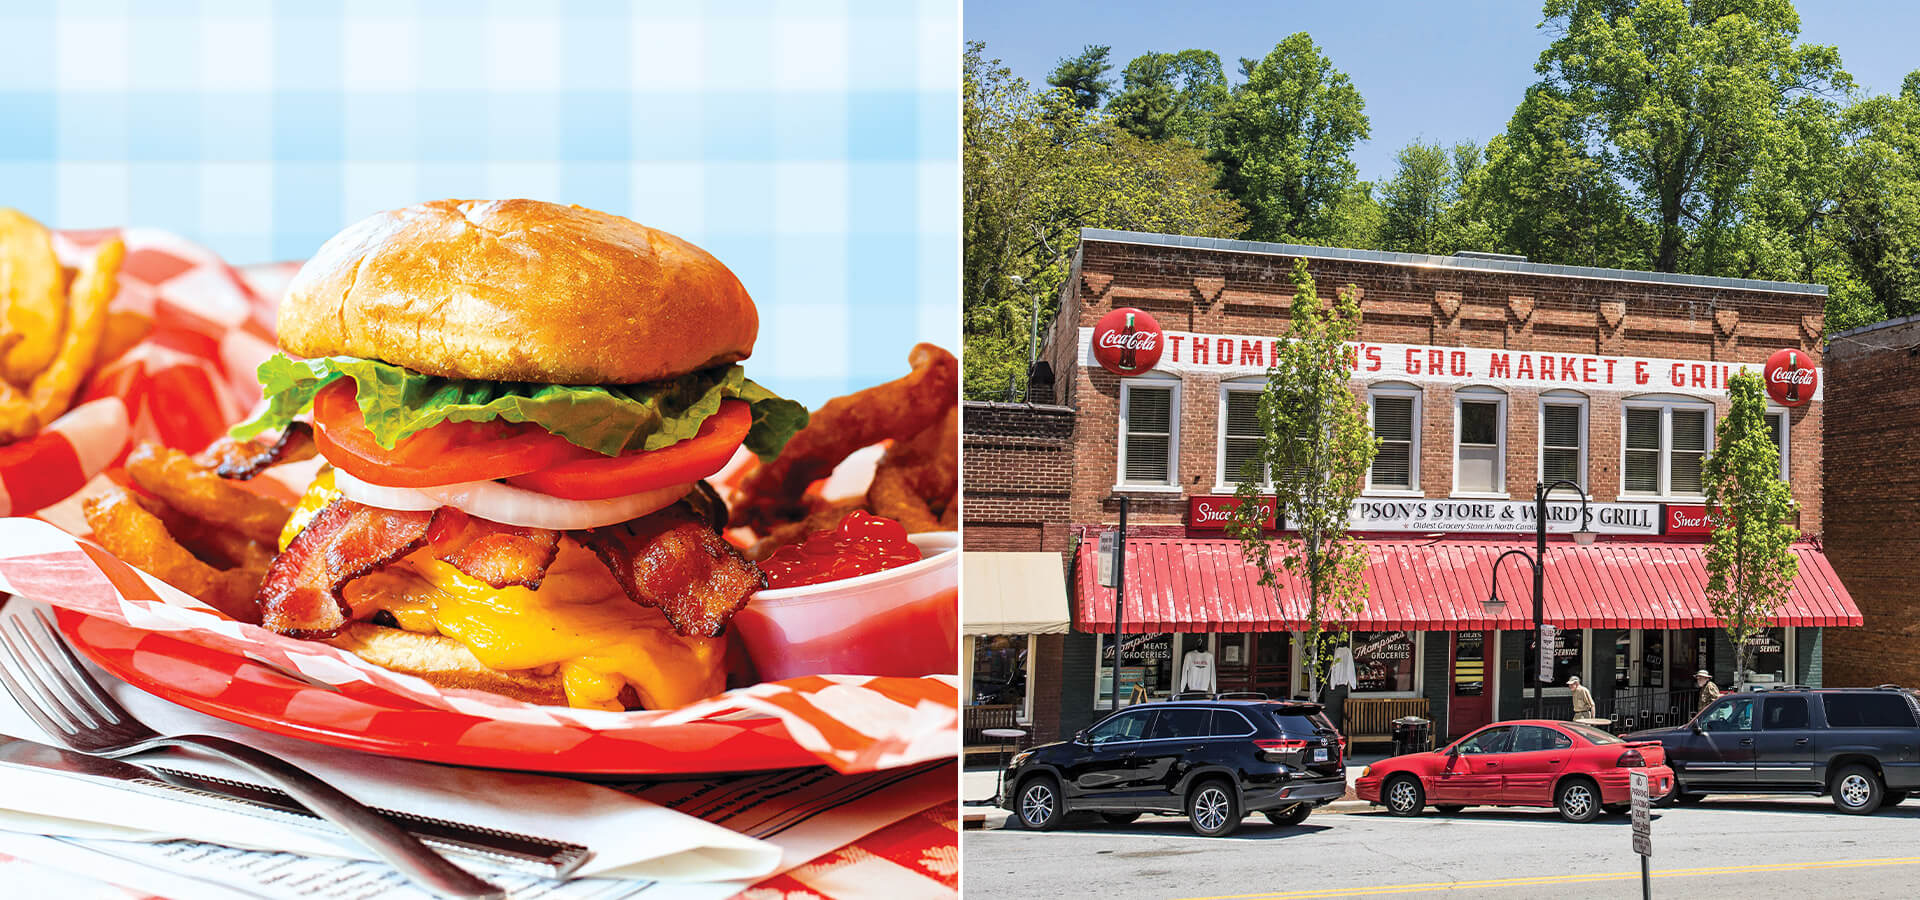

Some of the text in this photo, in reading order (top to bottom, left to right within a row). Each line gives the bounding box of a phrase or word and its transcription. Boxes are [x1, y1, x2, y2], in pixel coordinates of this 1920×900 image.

[1099, 329, 1159, 351] Coca-Cola
[1168, 335, 1745, 390] THOMN'S GRO. MARKET & GRIL
[1771, 367, 1815, 385] Coca-Cola
[1196, 503, 1231, 522] Since
[1433, 503, 1496, 519] STORE
[1501, 505, 1515, 519] &
[1600, 507, 1652, 528] GRILL
[1672, 511, 1701, 528] Since
[1437, 522, 1465, 530] Grocery
[1516, 523, 1537, 531] Caroli
[1371, 651, 1410, 660] GROCERIES
[1388, 643, 1410, 651] MEATS
[1759, 645, 1780, 653] SERVICE
